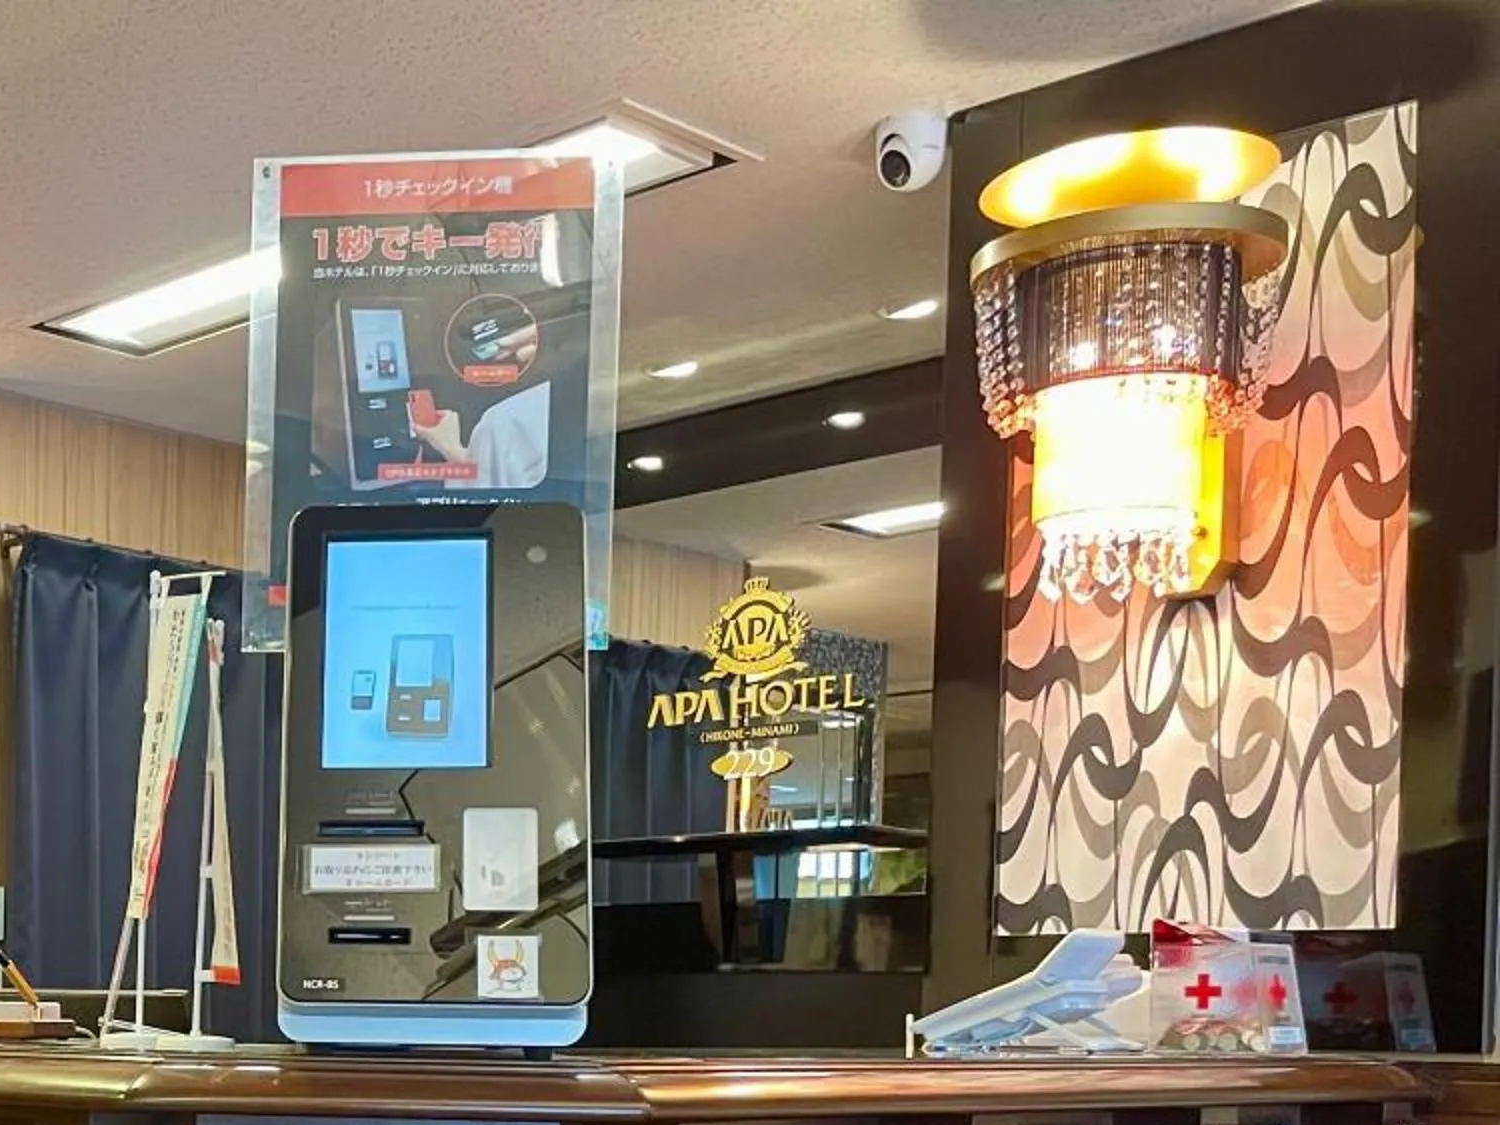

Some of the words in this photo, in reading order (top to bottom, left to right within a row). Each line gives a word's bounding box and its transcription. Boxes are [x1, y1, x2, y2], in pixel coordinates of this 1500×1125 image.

[722, 614, 789, 649] APA
[647, 689, 725, 728] APA
[729, 672, 866, 720] HOTEL
[723, 746, 776, 780] 229
